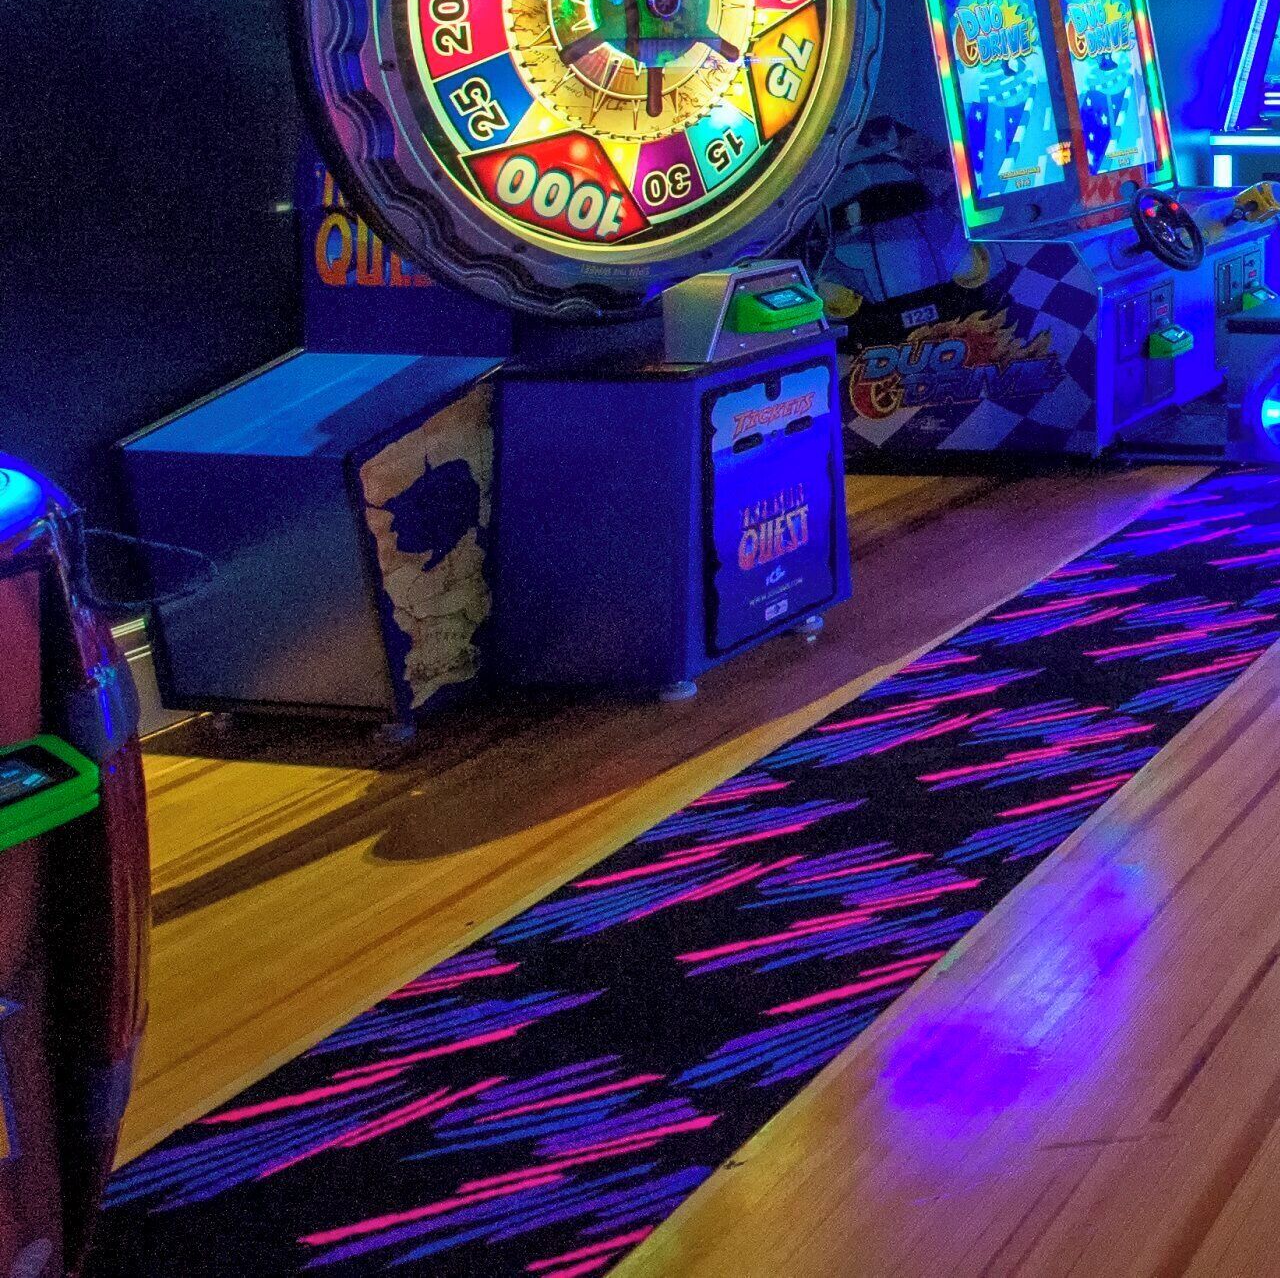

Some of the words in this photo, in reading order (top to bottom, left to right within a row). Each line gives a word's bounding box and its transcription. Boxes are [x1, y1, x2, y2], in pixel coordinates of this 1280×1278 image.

[957, 2, 1003, 40] DUO
[1068, 1, 1107, 33] DUO
[1086, 21, 1131, 55] DRIVE
[976, 21, 1031, 61] DRIVE
[764, 35, 815, 102] 75
[449, 76, 511, 142] 25
[704, 124, 747, 172] 15
[496, 154, 626, 240] 1000
[642, 162, 692, 206] 30
[863, 339, 966, 378] DUO
[732, 391, 816, 440] TICKETS
[738, 503, 809, 571] QUEST
